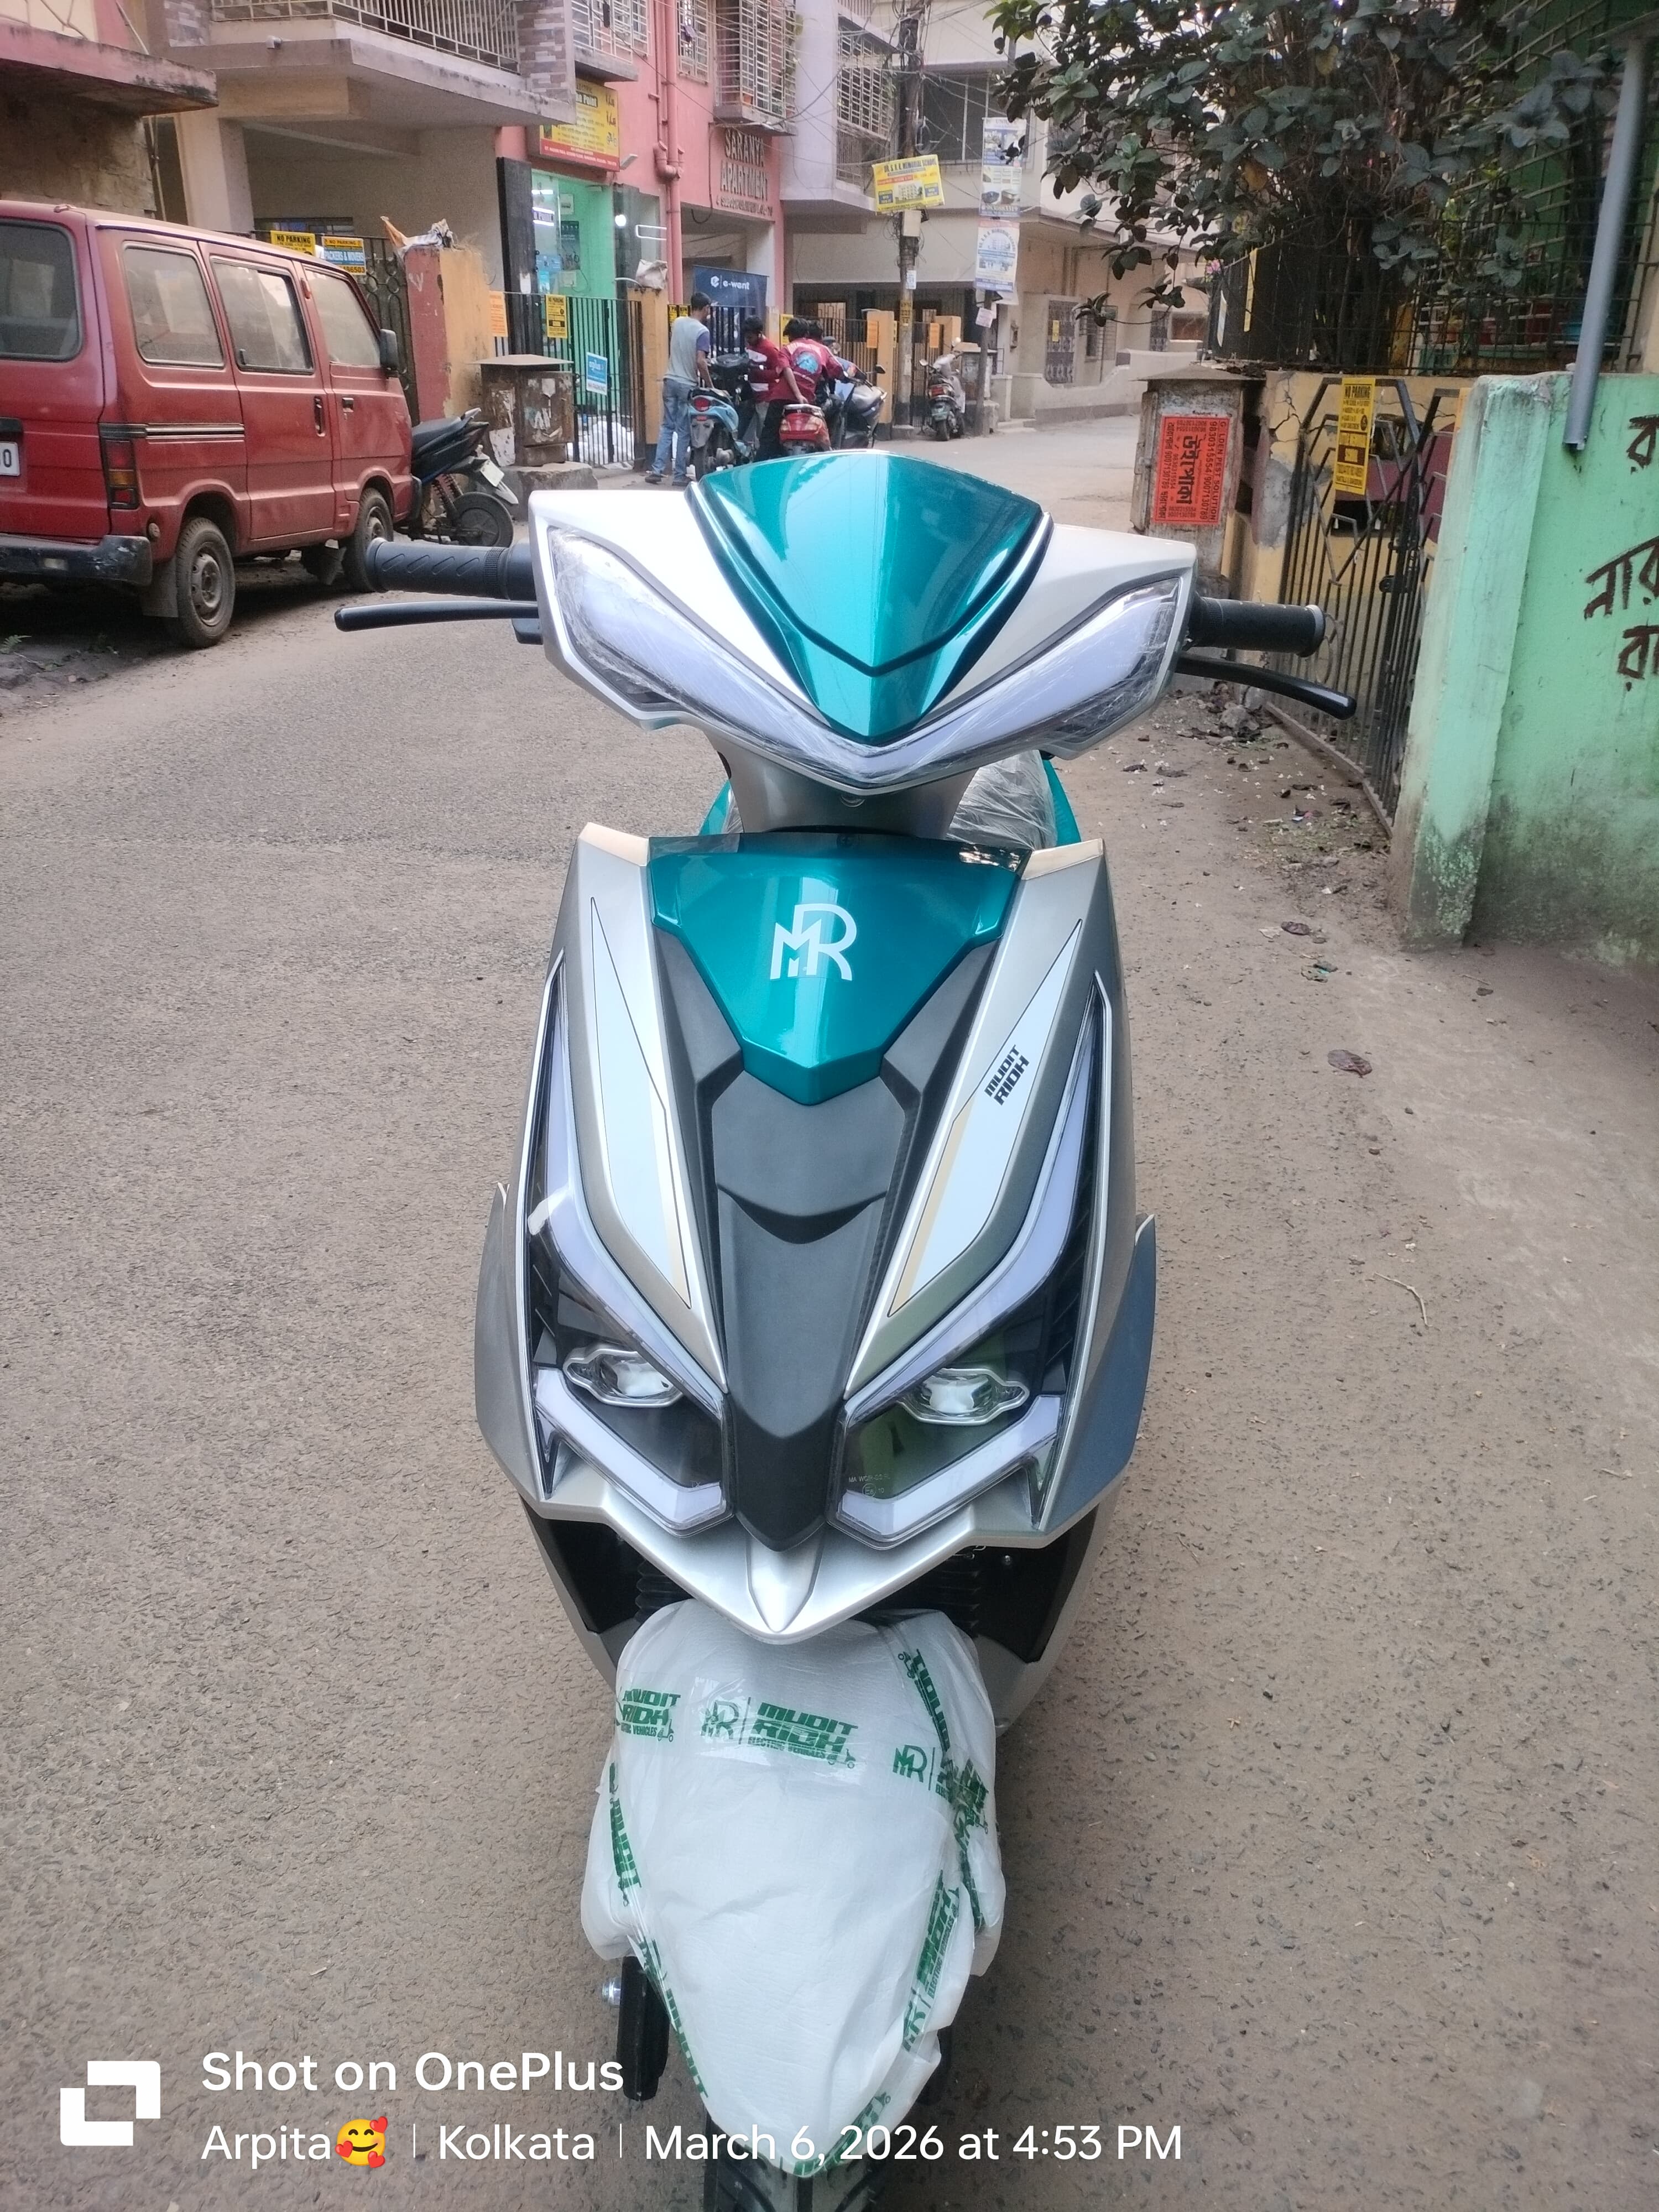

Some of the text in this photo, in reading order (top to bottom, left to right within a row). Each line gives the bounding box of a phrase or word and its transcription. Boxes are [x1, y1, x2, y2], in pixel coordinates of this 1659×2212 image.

[725, 128, 764, 167] SARANYA
[721, 159, 768, 201] APARTMENT
[286, 236, 311, 244] PARKING
[1345, 386, 1371, 398] NO PARKING
[1209, 479, 1220, 520] SOLUTION
[984, 1044, 1020, 1098] MUDIT
[632, 1724, 658, 1738] VEHICLES
[757, 1702, 858, 1735] MUDIT
[787, 1742, 826, 1760] VEHICLES
